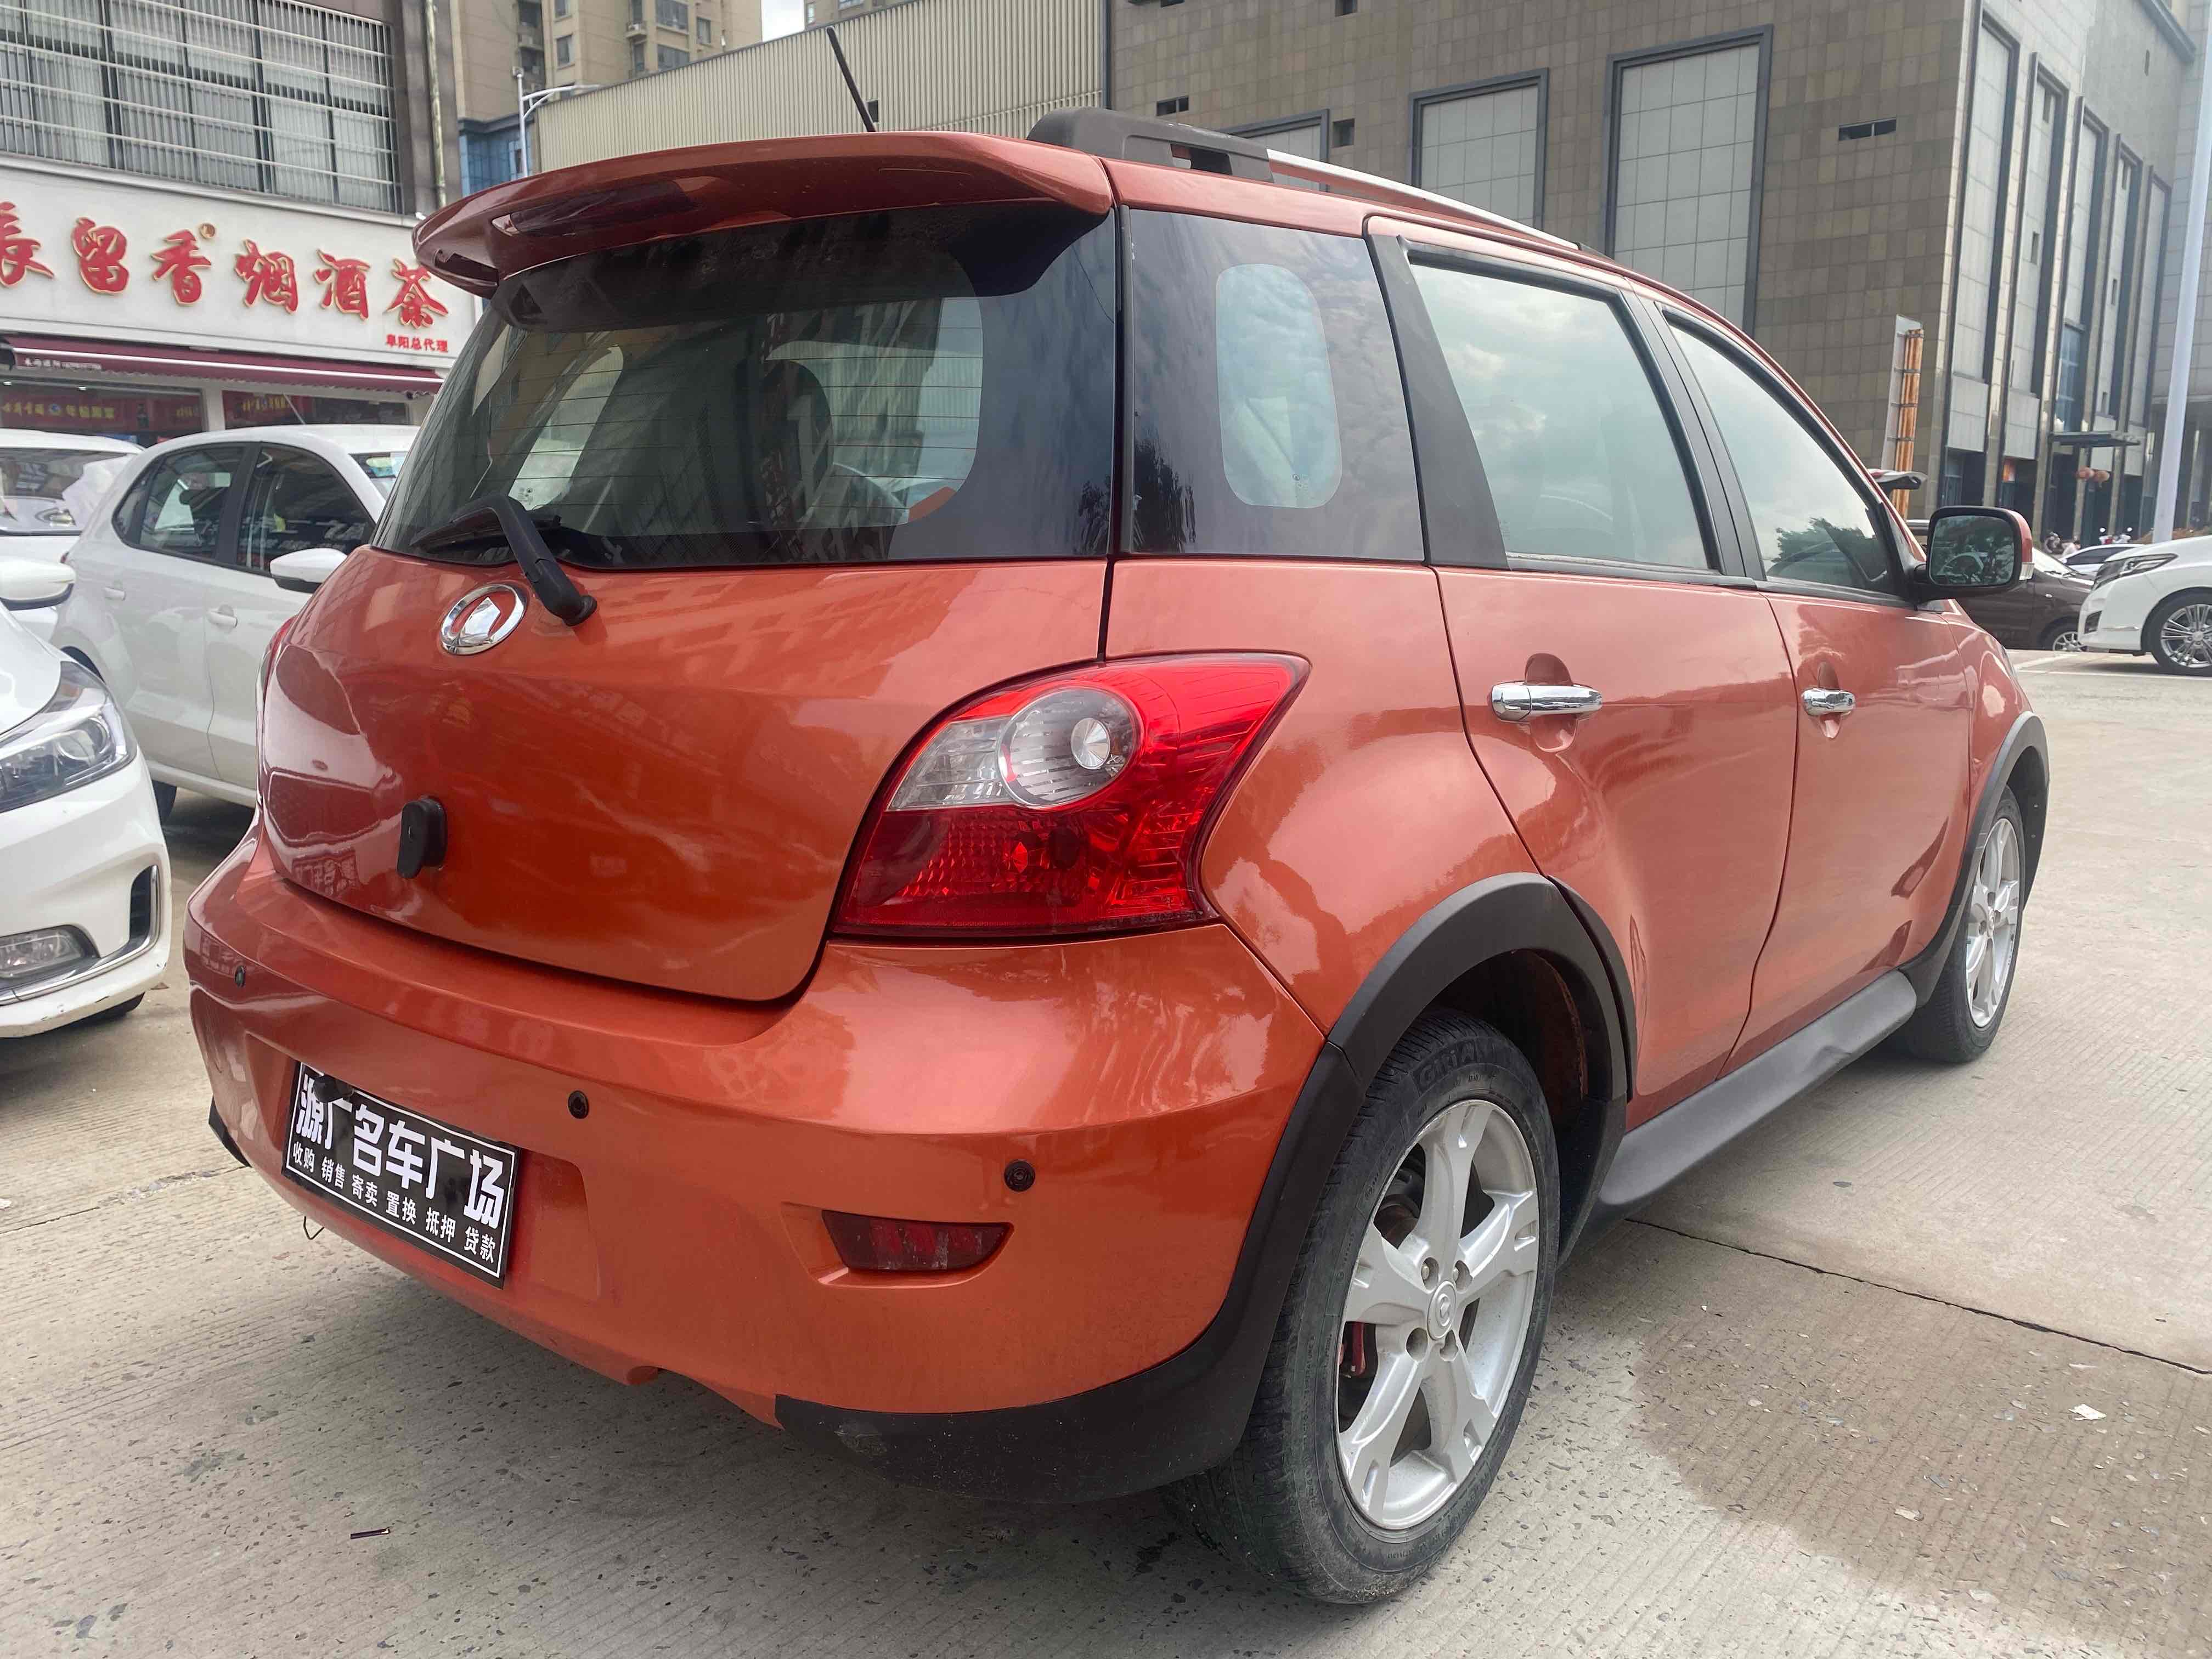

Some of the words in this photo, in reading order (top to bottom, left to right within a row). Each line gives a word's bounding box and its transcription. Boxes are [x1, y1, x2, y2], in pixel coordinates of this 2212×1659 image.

[386, 334, 449, 353] 阜阳总代理
[293, 1142, 315, 1172] 收购
[321, 1156, 346, 1189] 销售
[351, 1175, 378, 1207] 寄卖
[386, 1190, 416, 1224] 置换
[425, 1207, 456, 1243] 抵押
[464, 1226, 496, 1263] 贷款
